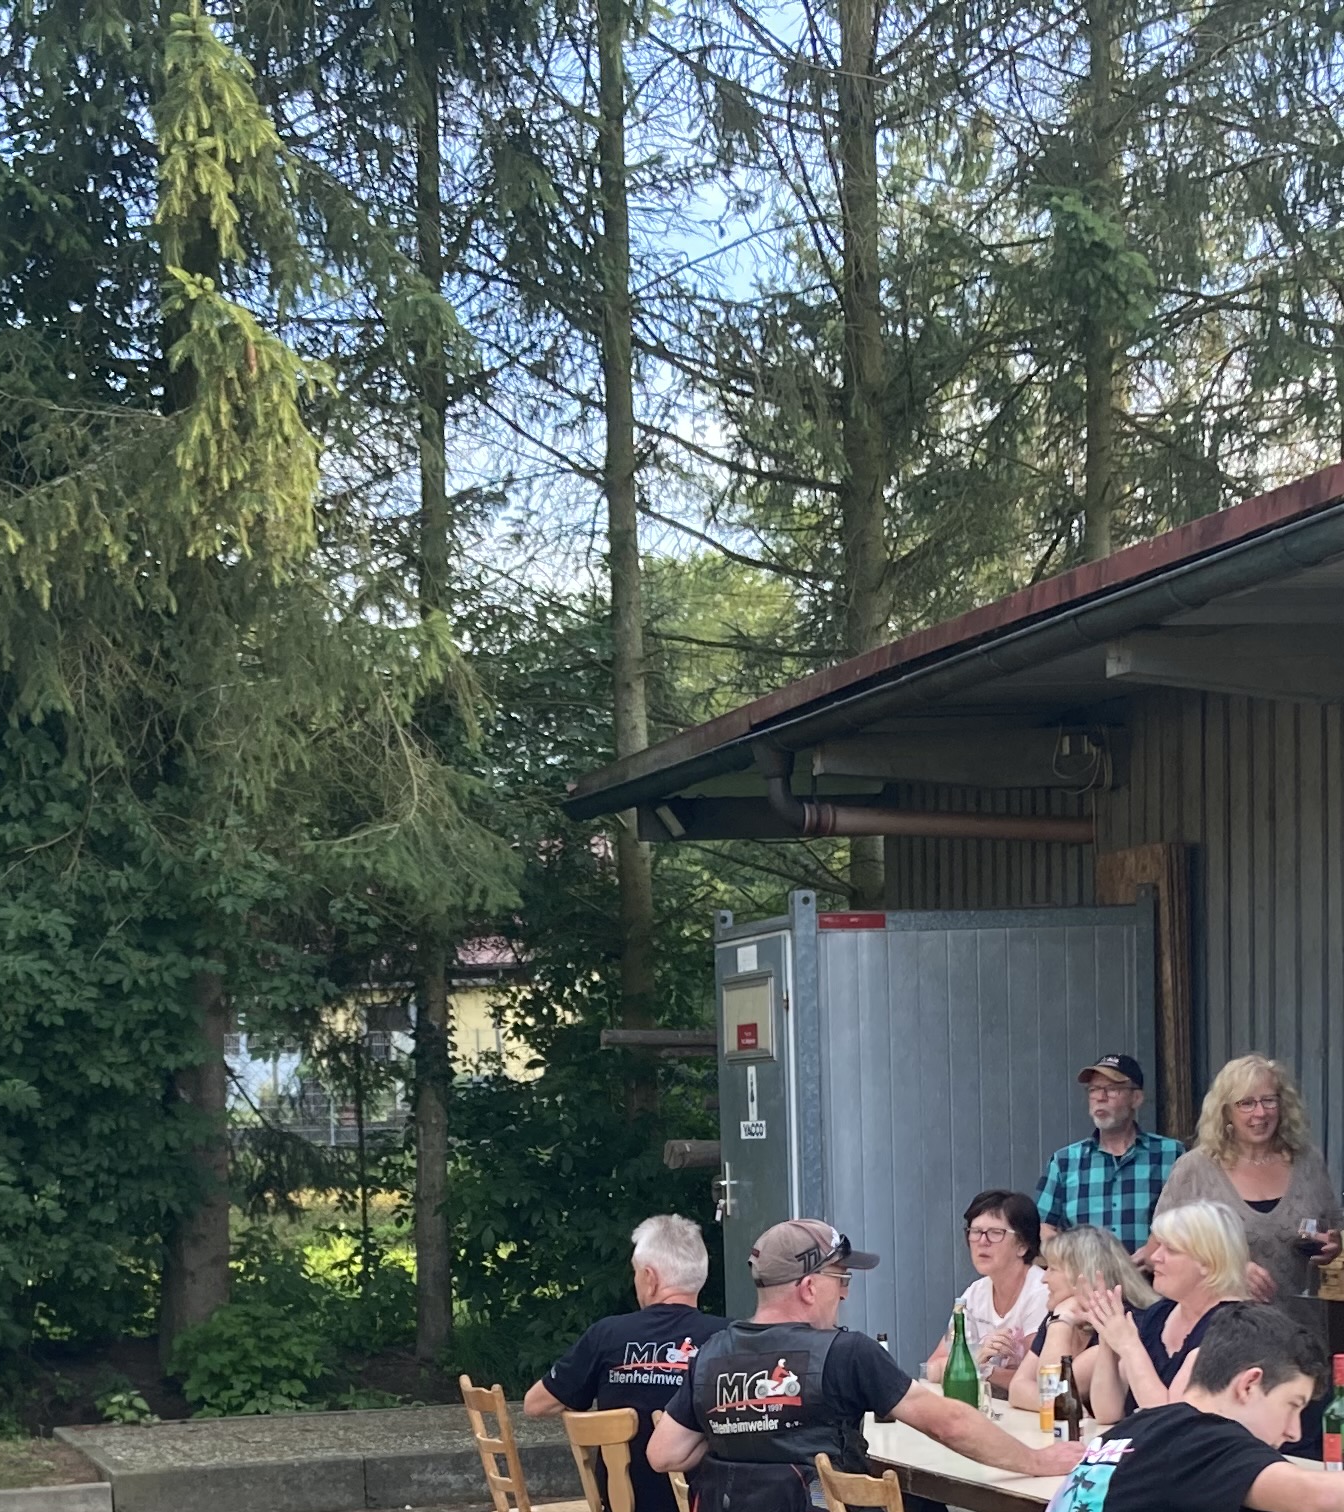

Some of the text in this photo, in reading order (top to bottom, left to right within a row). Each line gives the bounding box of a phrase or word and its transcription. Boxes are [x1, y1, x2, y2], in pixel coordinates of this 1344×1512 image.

[622, 1341, 676, 1373] MC
[608, 1369, 684, 1386] Ettenheimwe
[716, 1369, 769, 1413] MC
